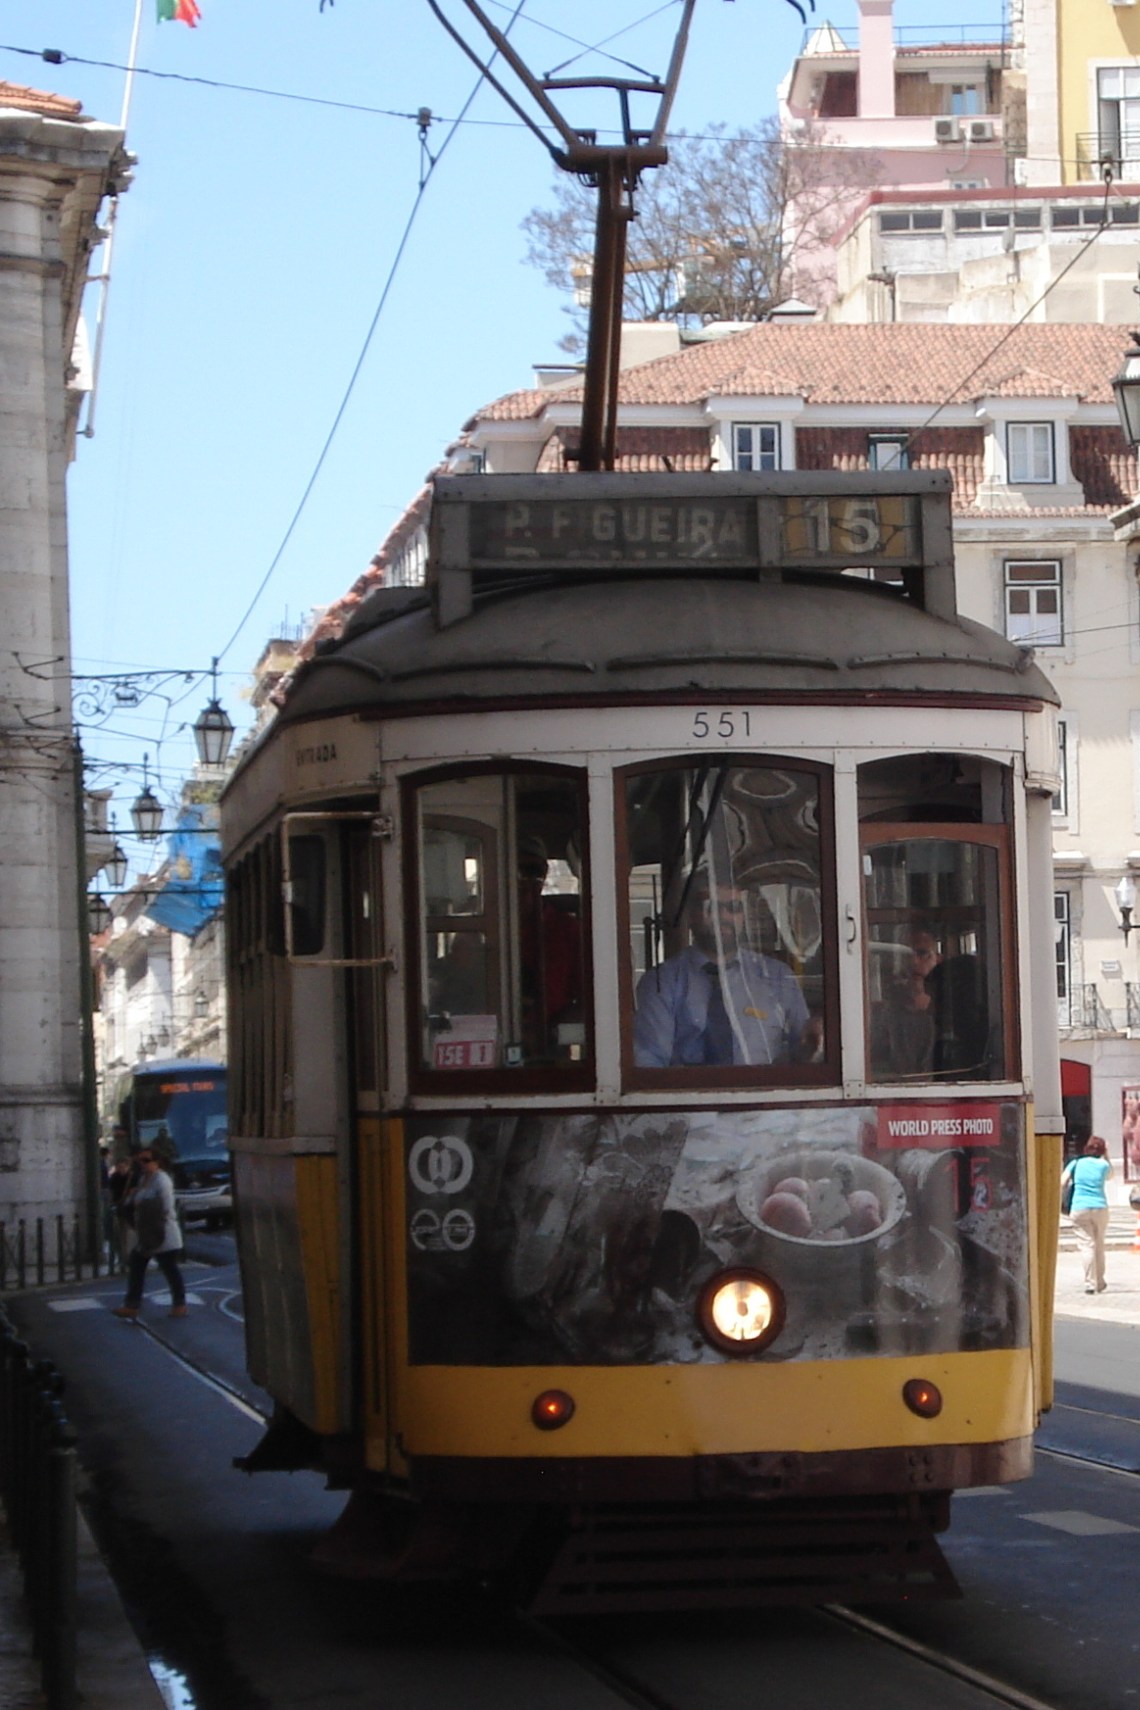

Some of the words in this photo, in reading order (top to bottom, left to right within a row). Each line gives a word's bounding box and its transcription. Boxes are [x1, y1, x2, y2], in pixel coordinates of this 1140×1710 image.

[551, 504, 744, 544] FGUEIRA
[805, 500, 881, 554] 15
[692, 711, 751, 739] 551
[888, 1119, 929, 1137] WORLD
[931, 1118, 962, 1136] PRESS
[963, 1117, 994, 1135] PHOTO
[942, 1156, 994, 1214] 15
